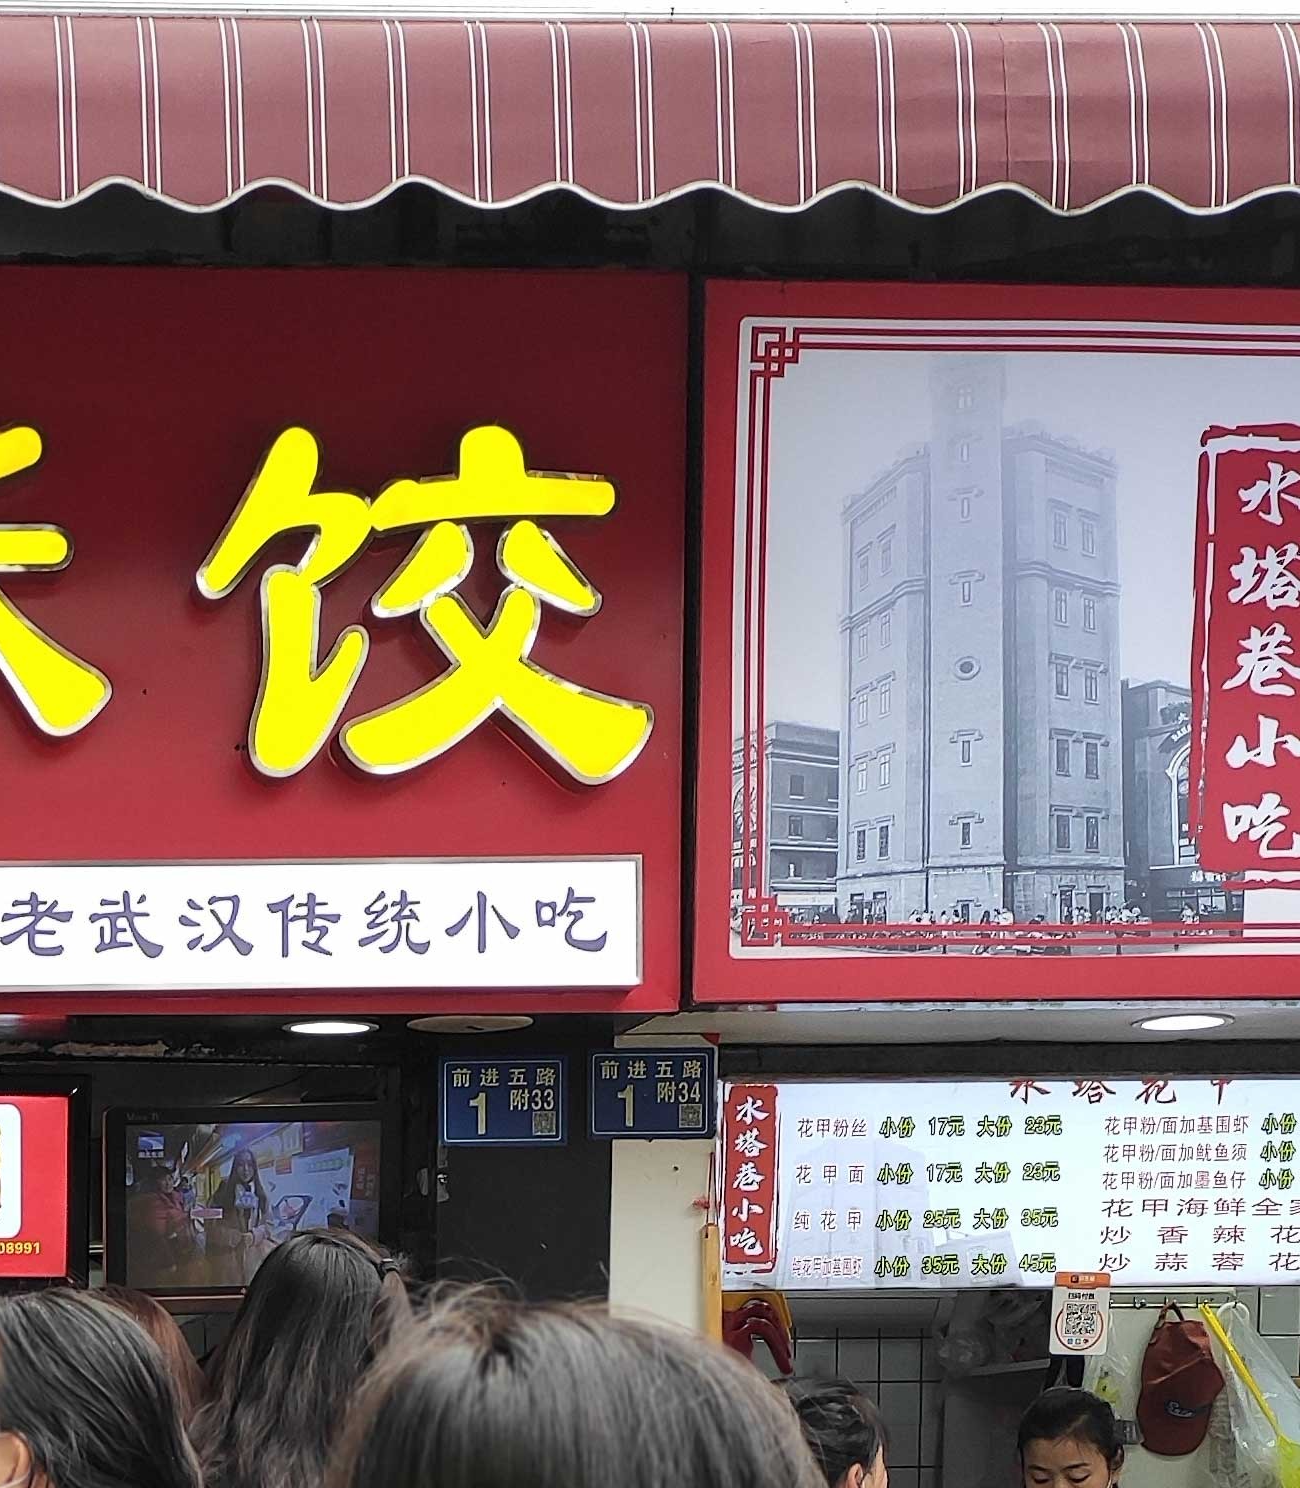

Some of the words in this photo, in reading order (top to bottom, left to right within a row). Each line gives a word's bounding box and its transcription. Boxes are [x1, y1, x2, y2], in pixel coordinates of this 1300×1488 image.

[1221, 460, 1300, 858] 水塔巷小吃
[451, 1068, 557, 1088] 前进五路
[600, 1060, 702, 1079] 前进五路
[509, 1089, 555, 1111] 附33
[656, 1082, 701, 1103] 附34
[469, 1092, 487, 1136] 1
[617, 1084, 634, 1128] 1
[797, 1118, 868, 1139] 花甲粉丝
[879, 1116, 915, 1138] 小份
[929, 1115, 965, 1137] 17元
[977, 1115, 1012, 1137] 大份
[1025, 1115, 1062, 1136] 23元
[1104, 1115, 1249, 1136] 花甲粉/面加基围虾
[1261, 1113, 1297, 1134] 小份
[1103, 1142, 1248, 1163] 花甲粉/面加鱿鱼须
[1260, 1140, 1296, 1162] 小份
[729, 1096, 770, 1256] 水塔巷小吃
[795, 1164, 865, 1185] 花甲面
[877, 1163, 913, 1184] 小份
[927, 1162, 962, 1183] 17元
[975, 1162, 1011, 1183] 大份
[1023, 1162, 1060, 1182] 23元
[1259, 1168, 1295, 1190] 小份
[794, 1210, 862, 1232] 纯花甲
[876, 1209, 912, 1231] 小份
[923, 1208, 961, 1229] 25元
[973, 1208, 1008, 1229] 大份
[1021, 1207, 1058, 1228] 35元
[1100, 1224, 1300, 1245] 炒香辣花
[874, 1255, 910, 1277] 小份
[922, 1254, 960, 1275] 35元
[972, 1253, 1007, 1275] 大份
[1019, 1253, 1056, 1273] 45元
[1099, 1251, 1300, 1273] 炒蒜蓉花
